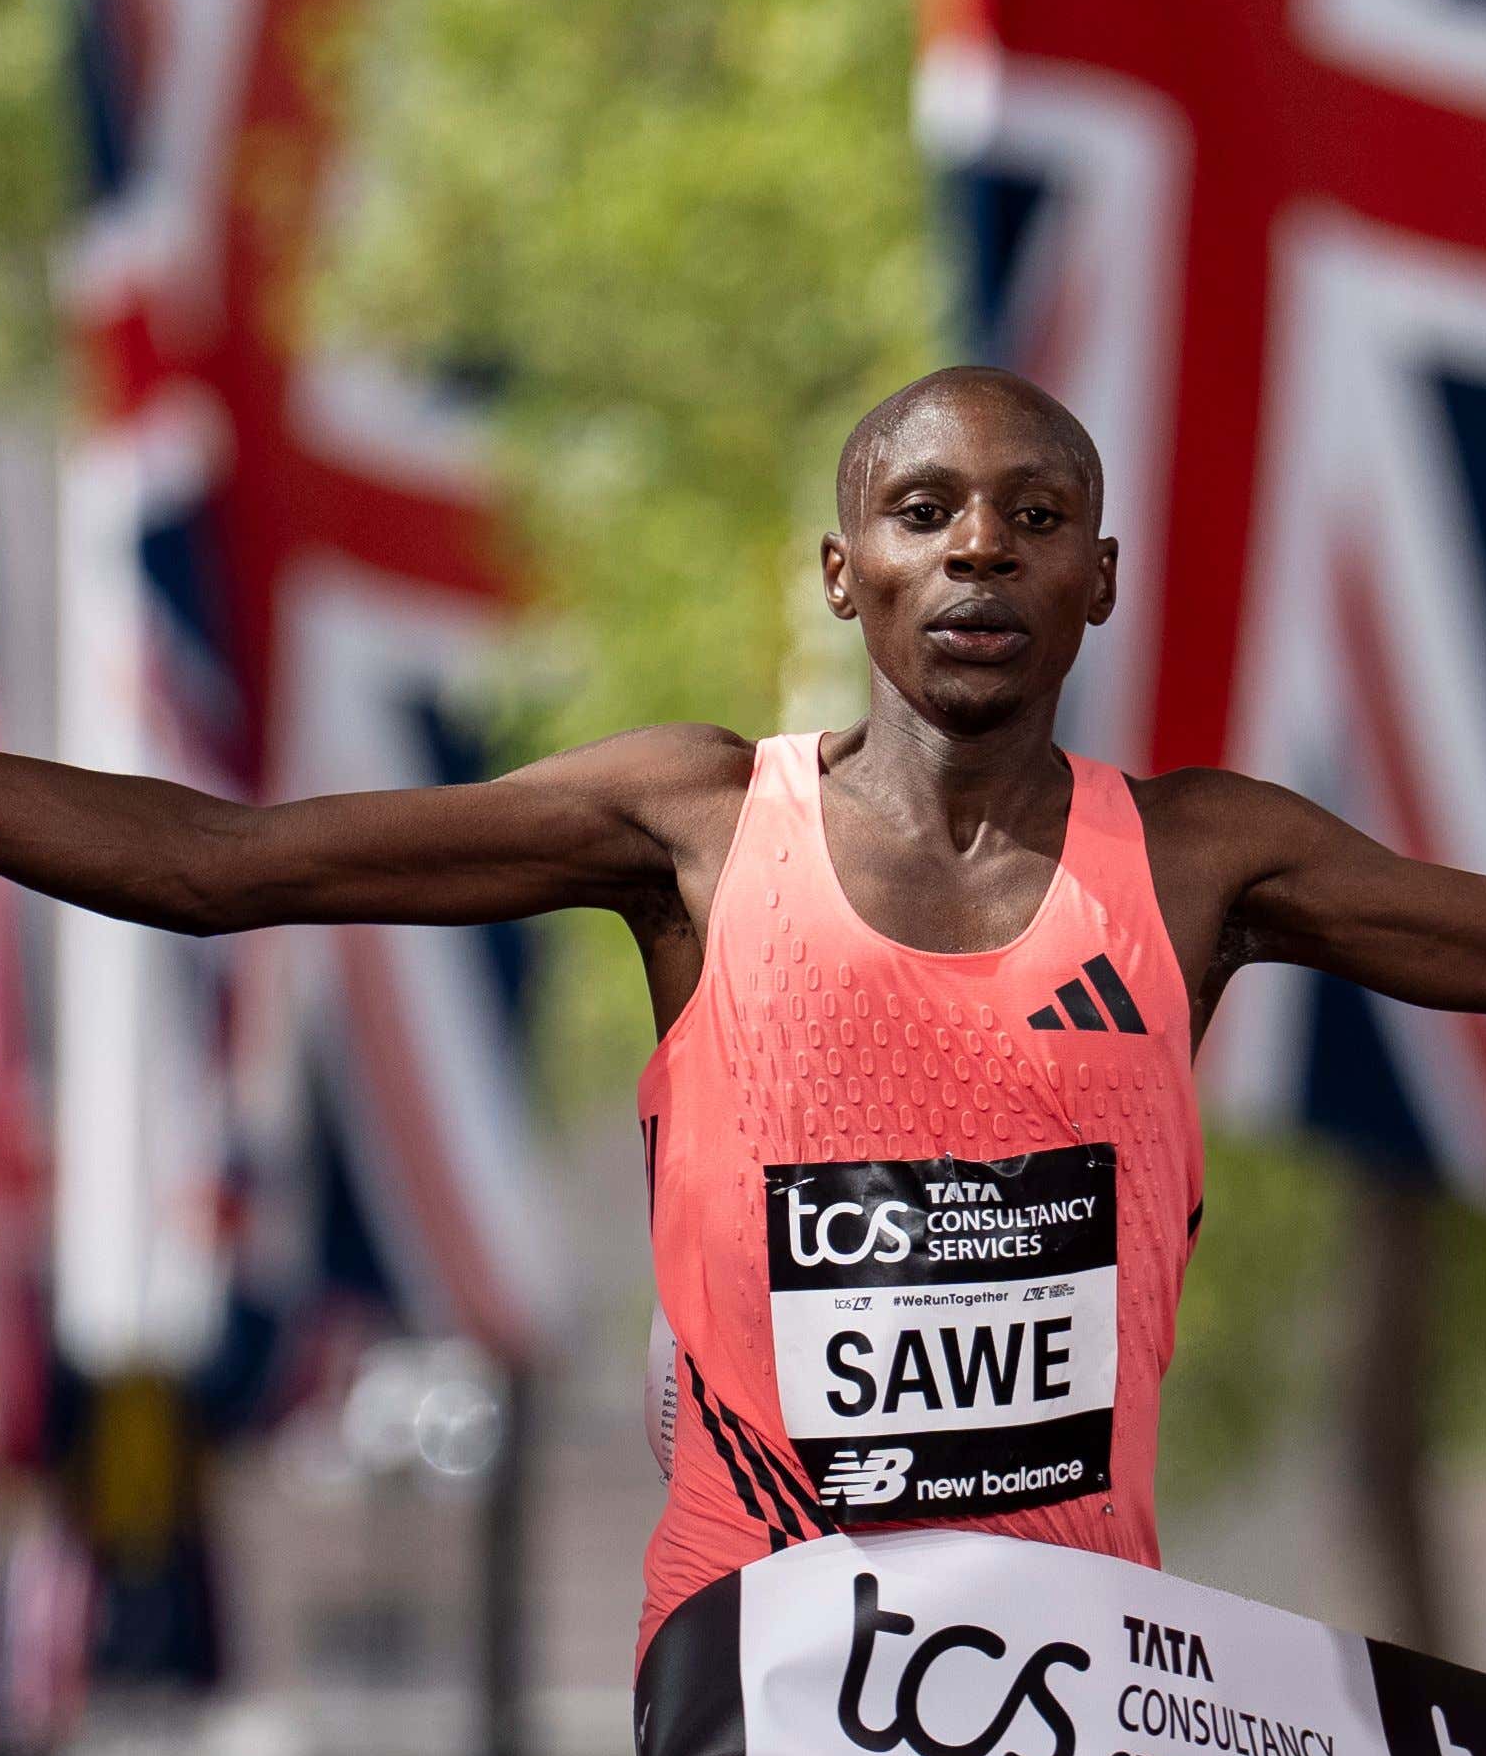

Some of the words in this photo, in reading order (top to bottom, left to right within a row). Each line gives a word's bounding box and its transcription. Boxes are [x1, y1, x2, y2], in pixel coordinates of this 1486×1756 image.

[925, 1181, 1003, 1204] TATA
[787, 1187, 912, 1267] tcs
[927, 1196, 1096, 1233] CONSULTANCY
[928, 1234, 1043, 1262] SERVICES
[893, 1291, 1009, 1307] #WeRunTogether
[826, 1316, 1073, 1418] SAWE
[917, 1476, 976, 1501] new
[982, 1458, 1084, 1496] balance
[1123, 1615, 1214, 1683] TATA
